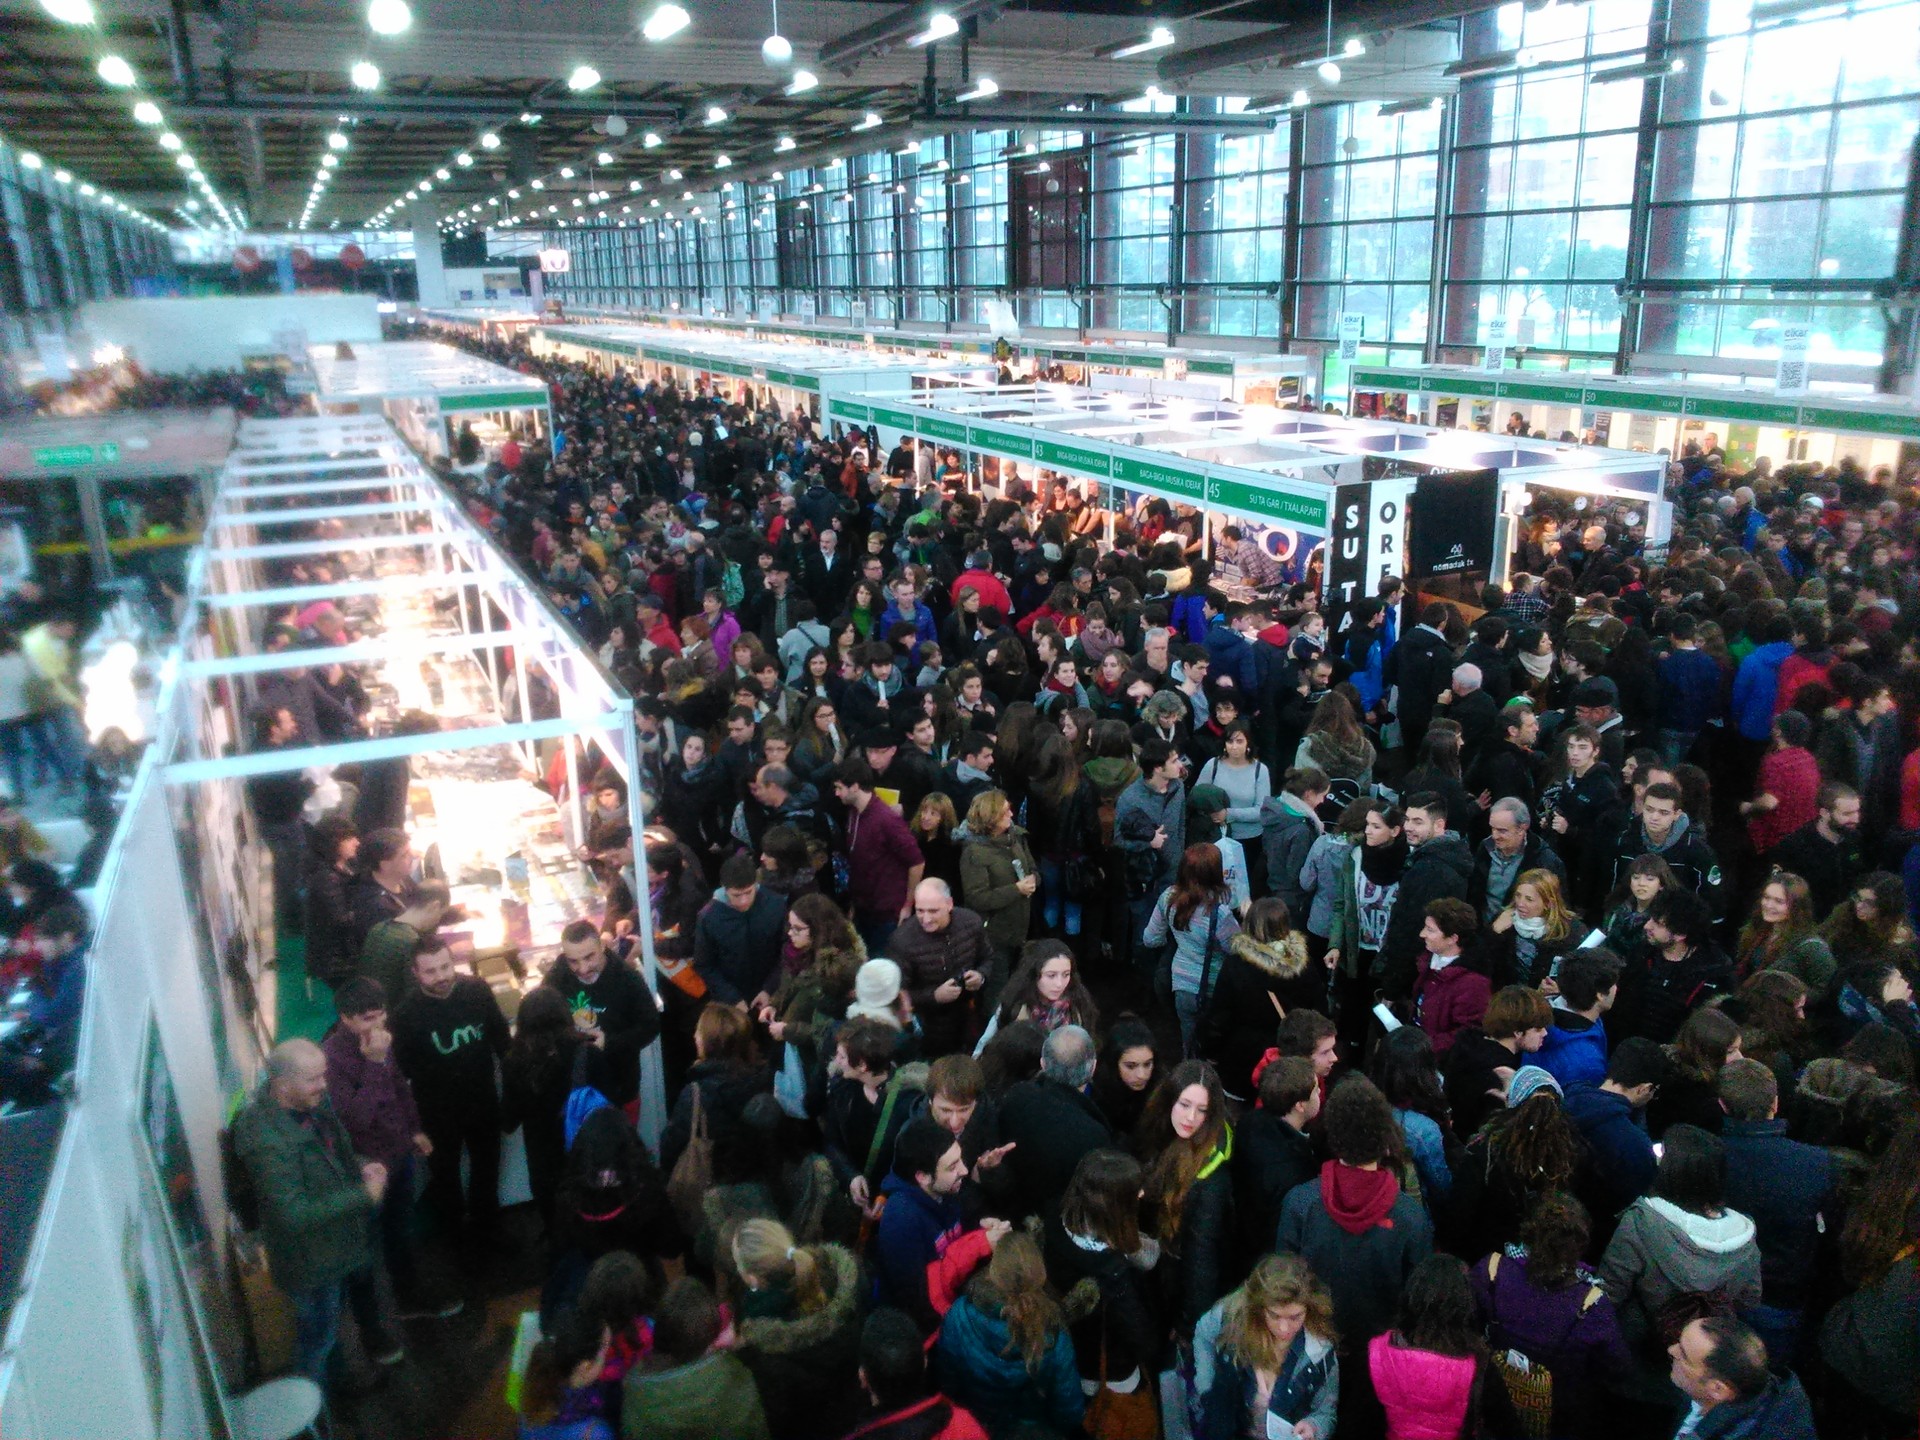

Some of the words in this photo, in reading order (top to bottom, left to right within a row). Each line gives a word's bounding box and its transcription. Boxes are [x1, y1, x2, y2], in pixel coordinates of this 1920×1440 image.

[1784, 327, 1808, 338] elkar
[1585, 392, 1596, 403] 50
[1686, 400, 1697, 412] 51
[1802, 411, 1816, 424] 52
[1035, 444, 1044, 457] 43
[1114, 459, 1123, 475] 44
[1139, 469, 1165, 484] BAGA-BIGA
[1165, 475, 1184, 488] MUSIKA
[1184, 479, 1203, 492] IDEIAK
[1208, 482, 1220, 499] 45
[1266, 498, 1280, 509] GAR
[1432, 560, 1465, 572] nomadak
